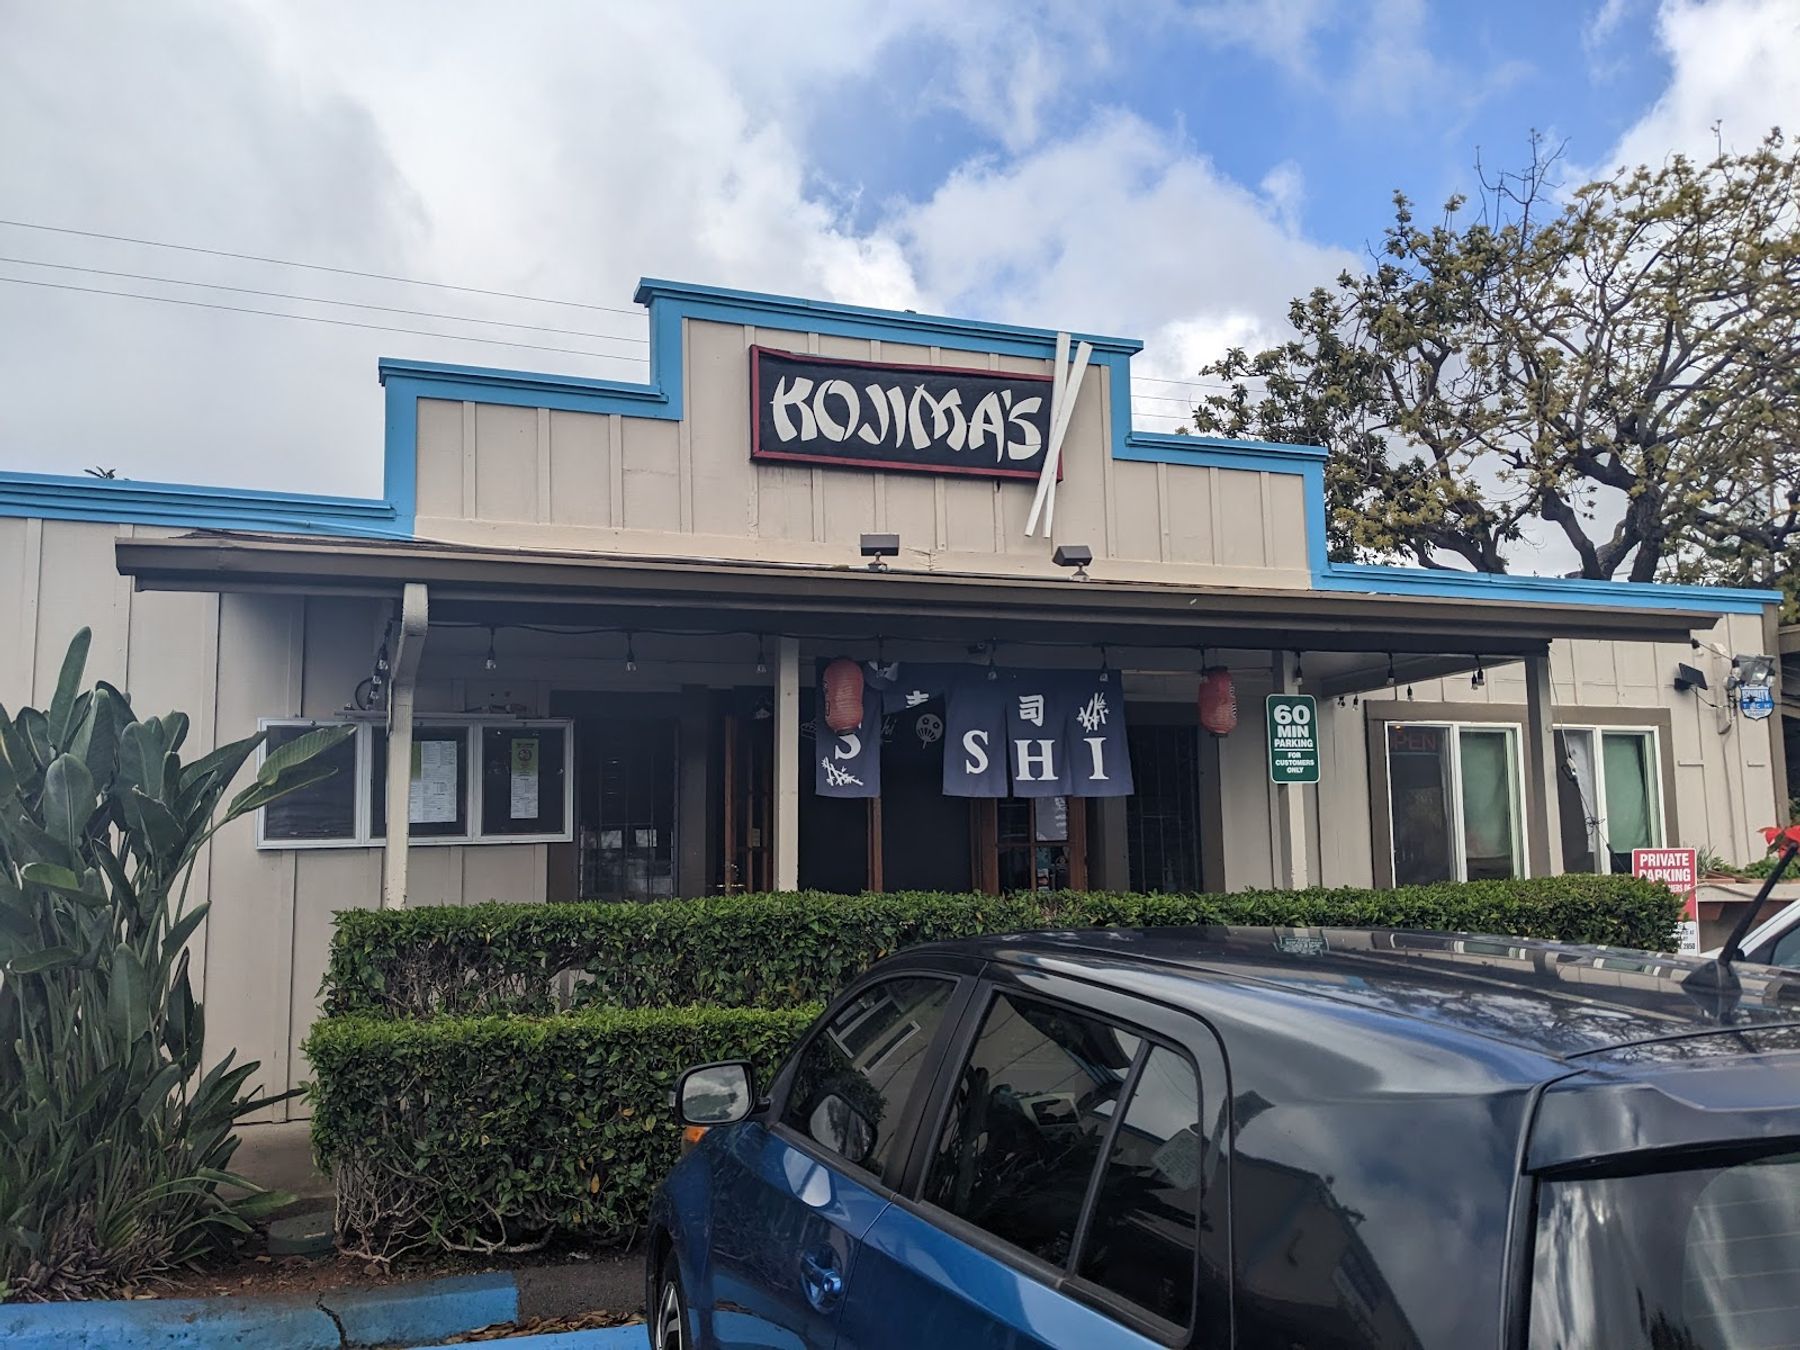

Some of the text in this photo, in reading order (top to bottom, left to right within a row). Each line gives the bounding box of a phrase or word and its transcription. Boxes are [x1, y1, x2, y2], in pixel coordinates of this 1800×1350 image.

[770, 375, 1043, 463] KOJIMA'S
[1273, 704, 1311, 725] 60
[1277, 725, 1309, 738] MIN
[1274, 738, 1314, 748] PARKING
[1275, 759, 1315, 767] CUSTOMERS
[1639, 852, 1690, 867] PRIVATE
